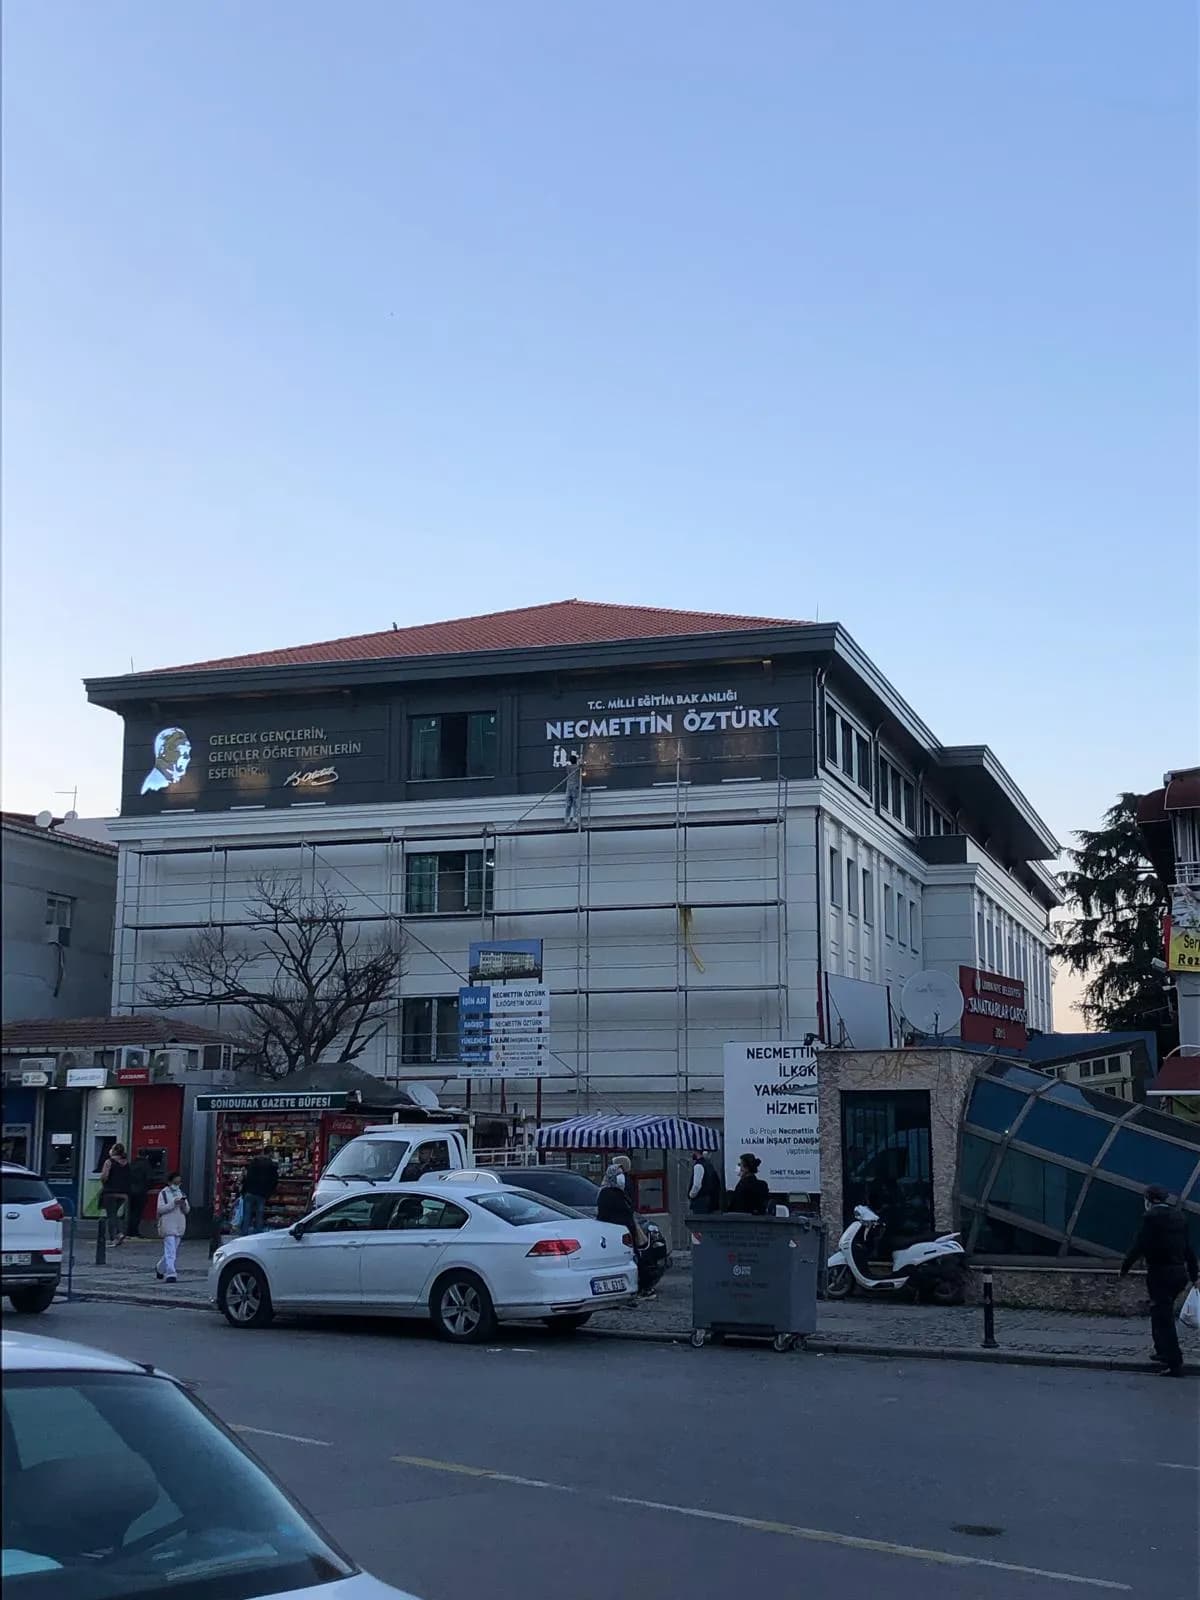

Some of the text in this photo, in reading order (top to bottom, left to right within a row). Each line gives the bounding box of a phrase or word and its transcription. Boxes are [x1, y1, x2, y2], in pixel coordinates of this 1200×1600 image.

[608, 696, 635, 709] MİLLİ
[637, 693, 675, 707] EĞİTİM
[546, 705, 780, 740] NECMETTİN ÖZTÜRK
[209, 733, 257, 746] GELECEK
[208, 740, 361, 764] GENÇLER ÖĞRETMENLERİN
[210, 1095, 332, 1109] SONDURAK GAZETE BÜFESİ
[766, 1099, 818, 1115] HİZMETİ
[778, 1127, 814, 1135] Necmettin
